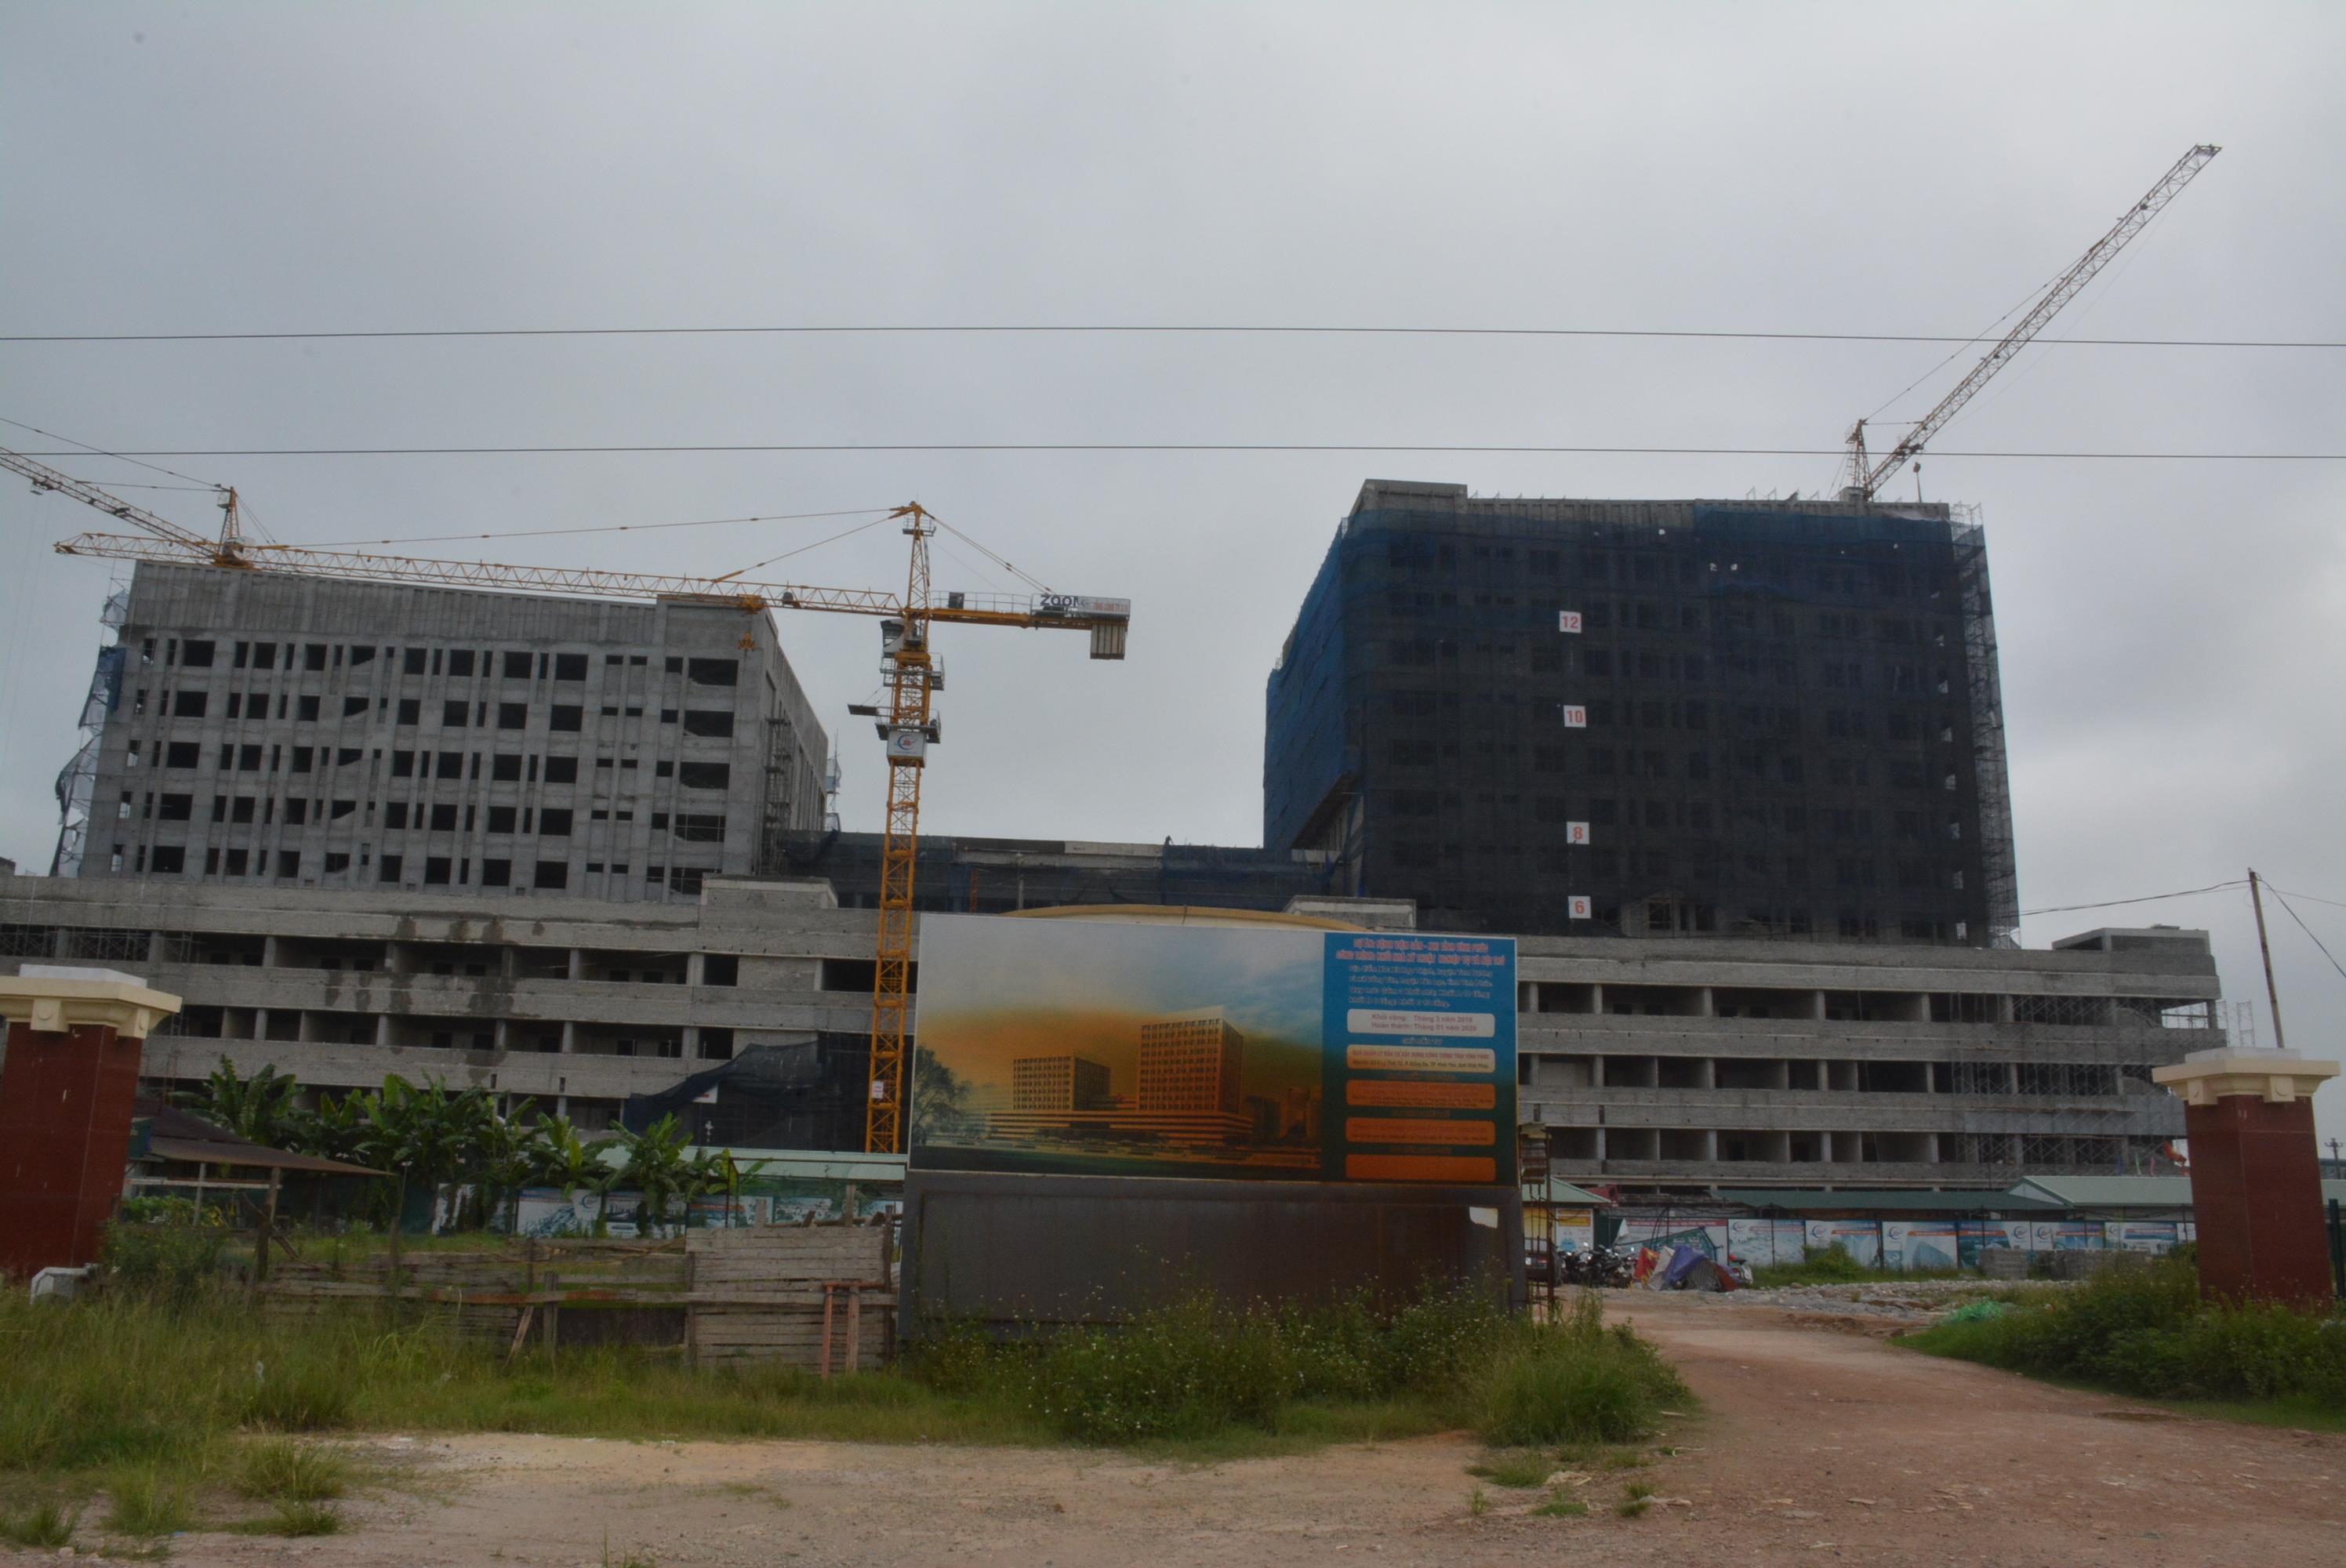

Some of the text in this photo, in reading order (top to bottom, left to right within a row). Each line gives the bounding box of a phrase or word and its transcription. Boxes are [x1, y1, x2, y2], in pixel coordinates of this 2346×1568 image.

[1562, 615, 1579, 629] 12
[1567, 710, 1582, 723] 10
[1573, 826, 1583, 840] 8
[1574, 900, 1585, 914] 6
